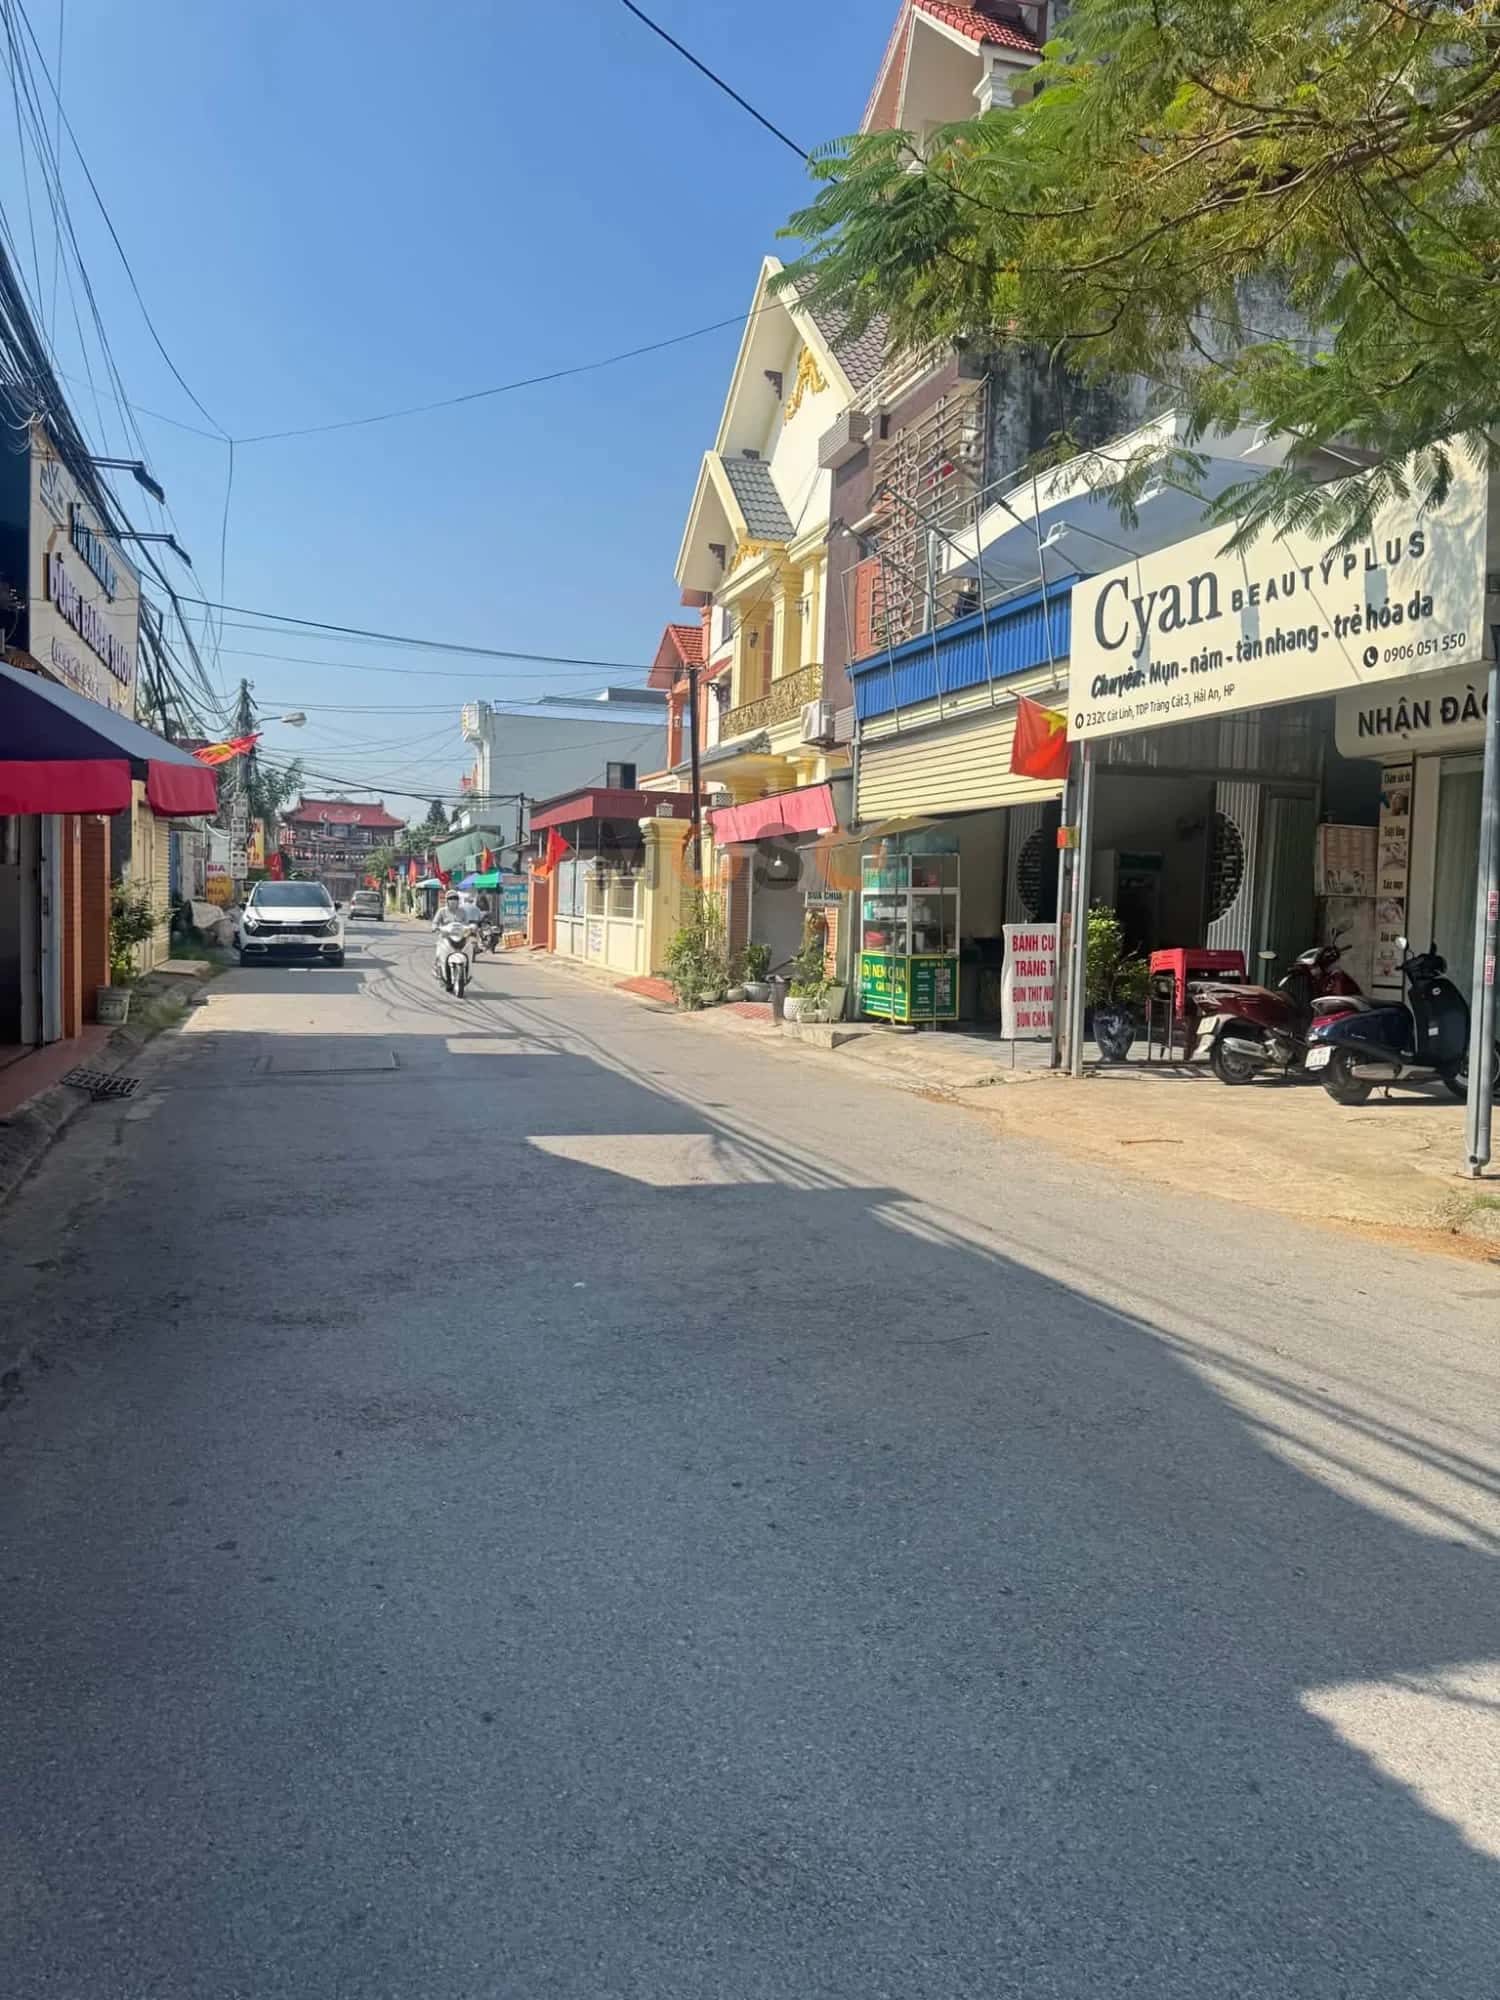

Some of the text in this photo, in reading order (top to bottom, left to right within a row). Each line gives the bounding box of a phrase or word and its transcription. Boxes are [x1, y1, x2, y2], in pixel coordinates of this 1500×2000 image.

[1094, 530, 1425, 658] Cyan BEAUTY PLUS
[1149, 660, 1179, 685] Mụn
[1190, 646, 1223, 674] nám
[1236, 634, 1263, 663] tàn
[1265, 625, 1319, 657] nhang
[1334, 603, 1362, 640] trẻ
[1366, 596, 1404, 632] hóa
[1407, 590, 1434, 620] da
[1383, 631, 1466, 664] 0906 051 550
[1223, 682, 1236, 698] HP
[1358, 684, 1489, 740] NHẬN ĐÀ
